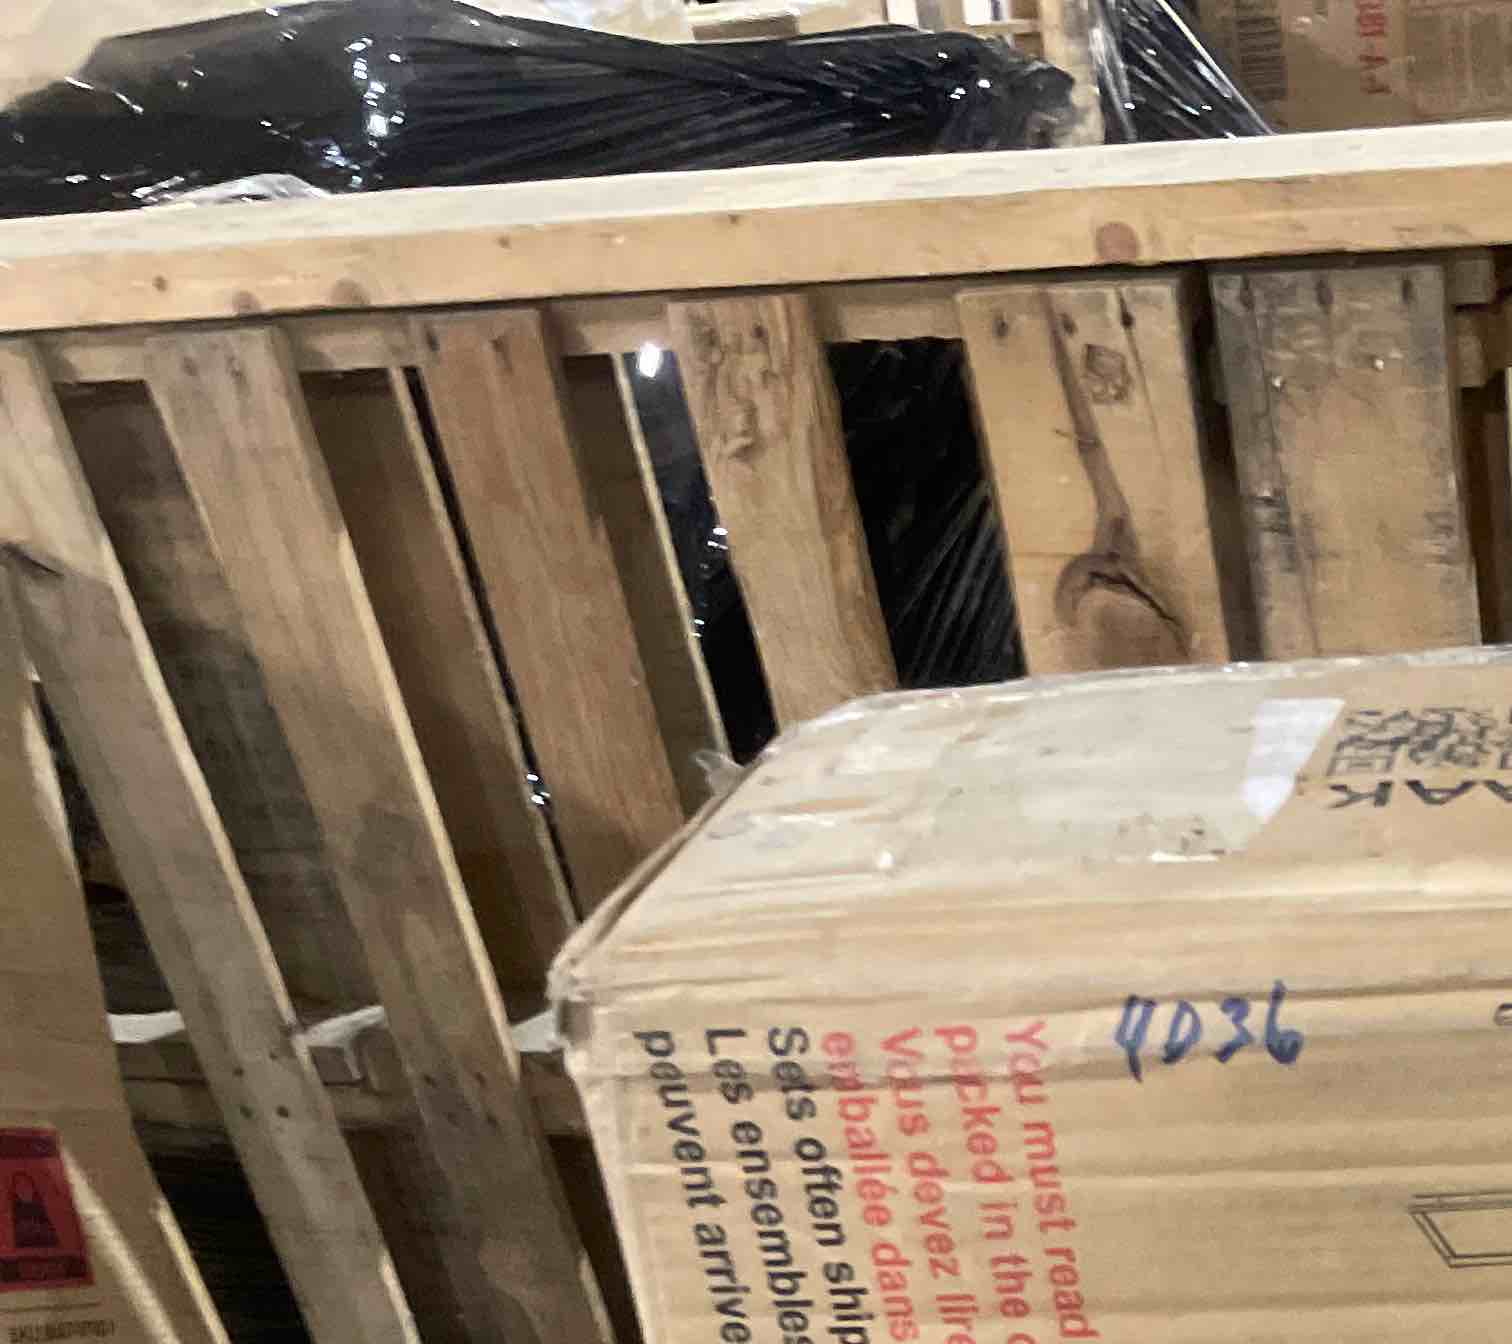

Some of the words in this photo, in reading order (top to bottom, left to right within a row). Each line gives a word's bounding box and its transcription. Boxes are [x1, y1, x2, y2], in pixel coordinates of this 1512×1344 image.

[705, 1029, 752, 1103] Les
[934, 1025, 1009, 1184] packed
[1005, 1022, 1048, 1104] You
[632, 1031, 722, 1208] peuvent
[766, 1027, 818, 1120] Sets
[792, 1137, 849, 1246] often
[879, 1026, 933, 1135] Vous
[906, 1152, 961, 1276] devez
[820, 1032, 892, 1225] emballée
[870, 1243, 920, 1341] dans
[979, 1202, 1019, 1239] in
[1017, 1122, 1075, 1231] must
[990, 1255, 1033, 1318] the
[1043, 1247, 1097, 1339] read
